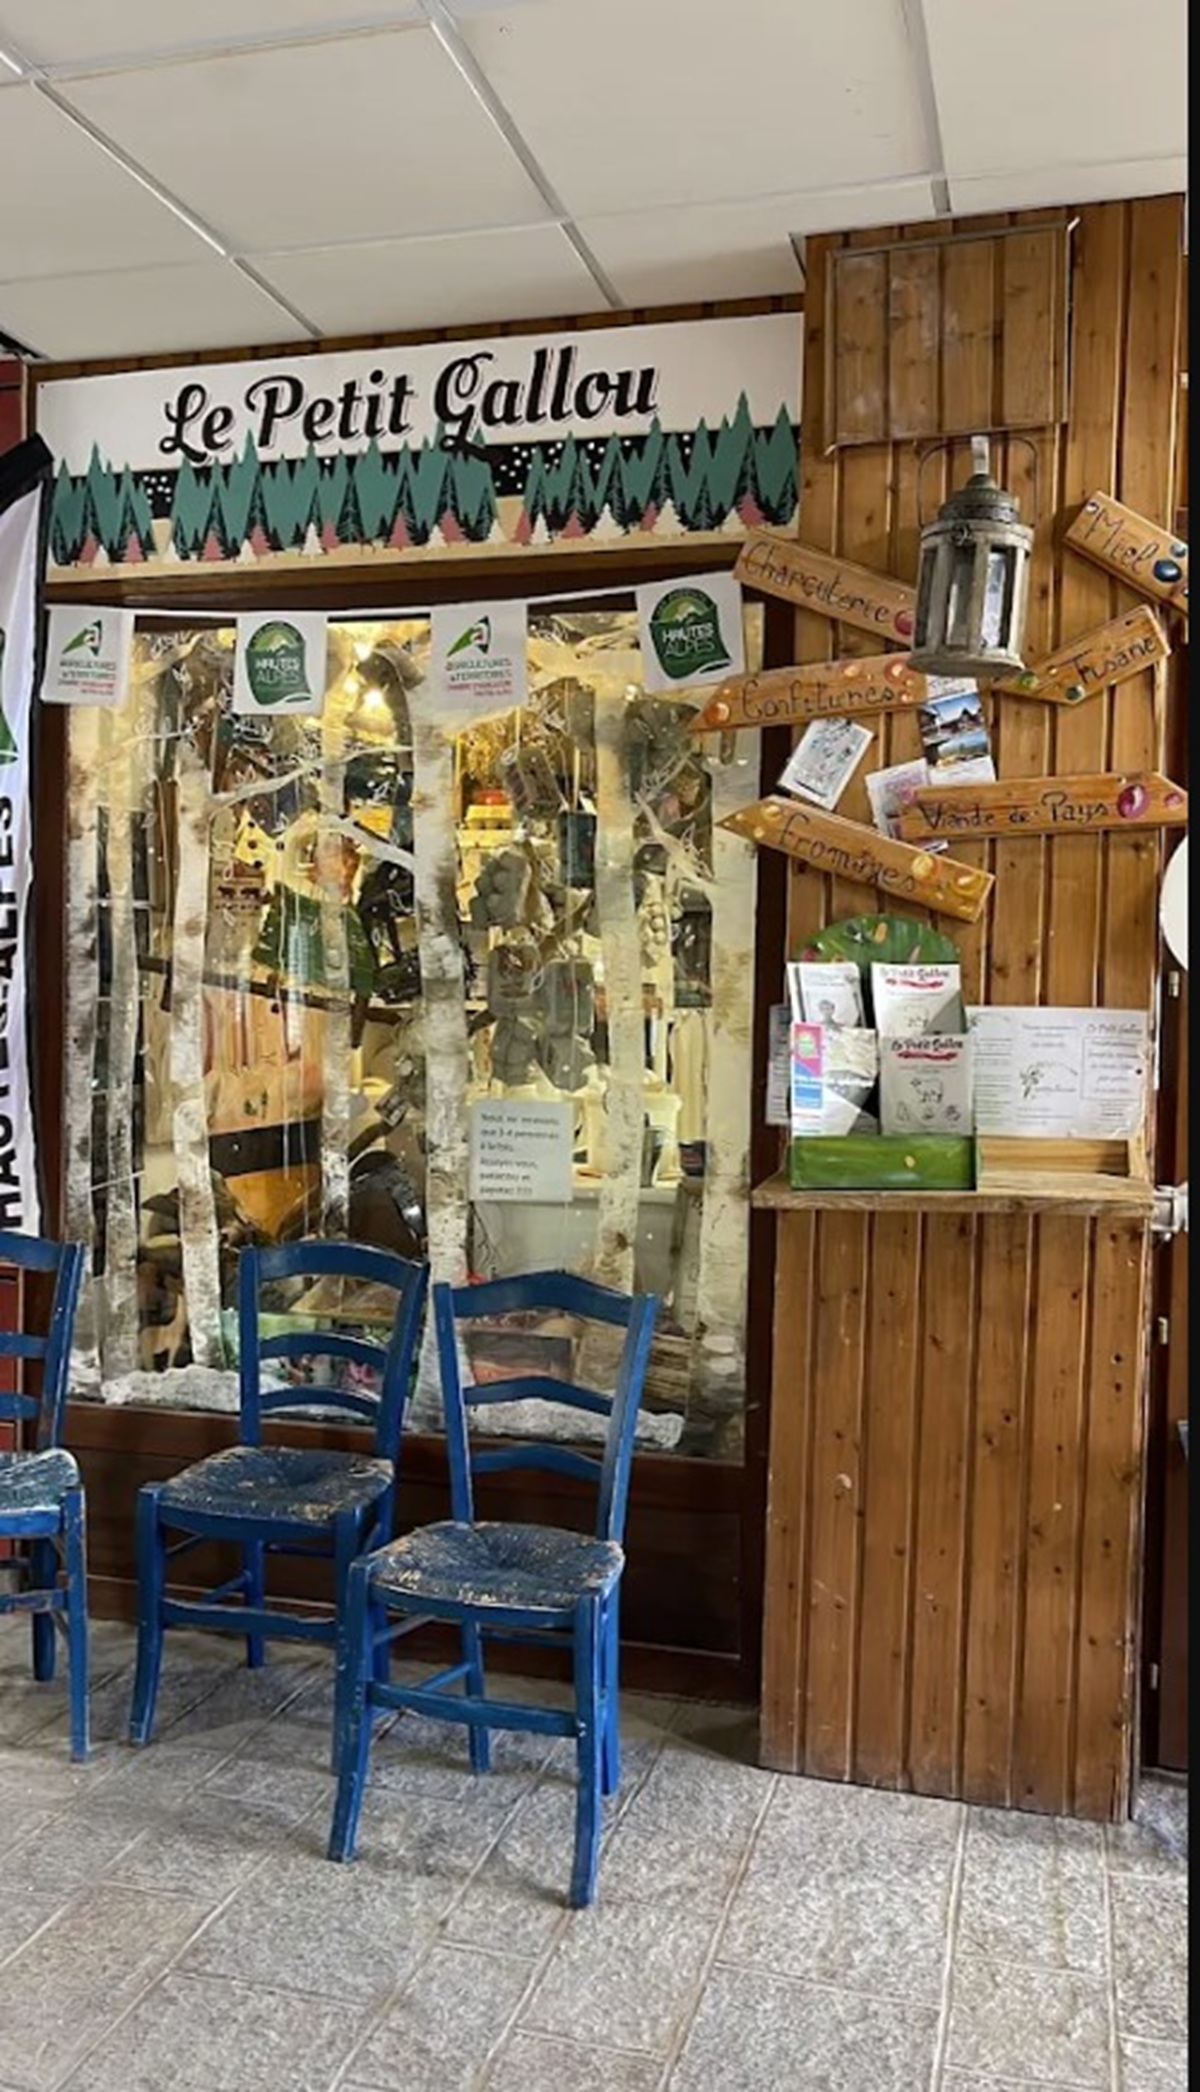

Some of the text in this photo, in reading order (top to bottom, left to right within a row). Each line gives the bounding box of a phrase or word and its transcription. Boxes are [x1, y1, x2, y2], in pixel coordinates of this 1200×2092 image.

[159, 345, 659, 462] Le Petit Gallou
[1085, 508, 1160, 575] Miel
[742, 540, 890, 623] Charcuterie
[661, 622, 715, 643] HAUTES
[742, 680, 895, 720] Confitures
[917, 801, 995, 830] Viande
[1040, 791, 1110, 824] Pays
